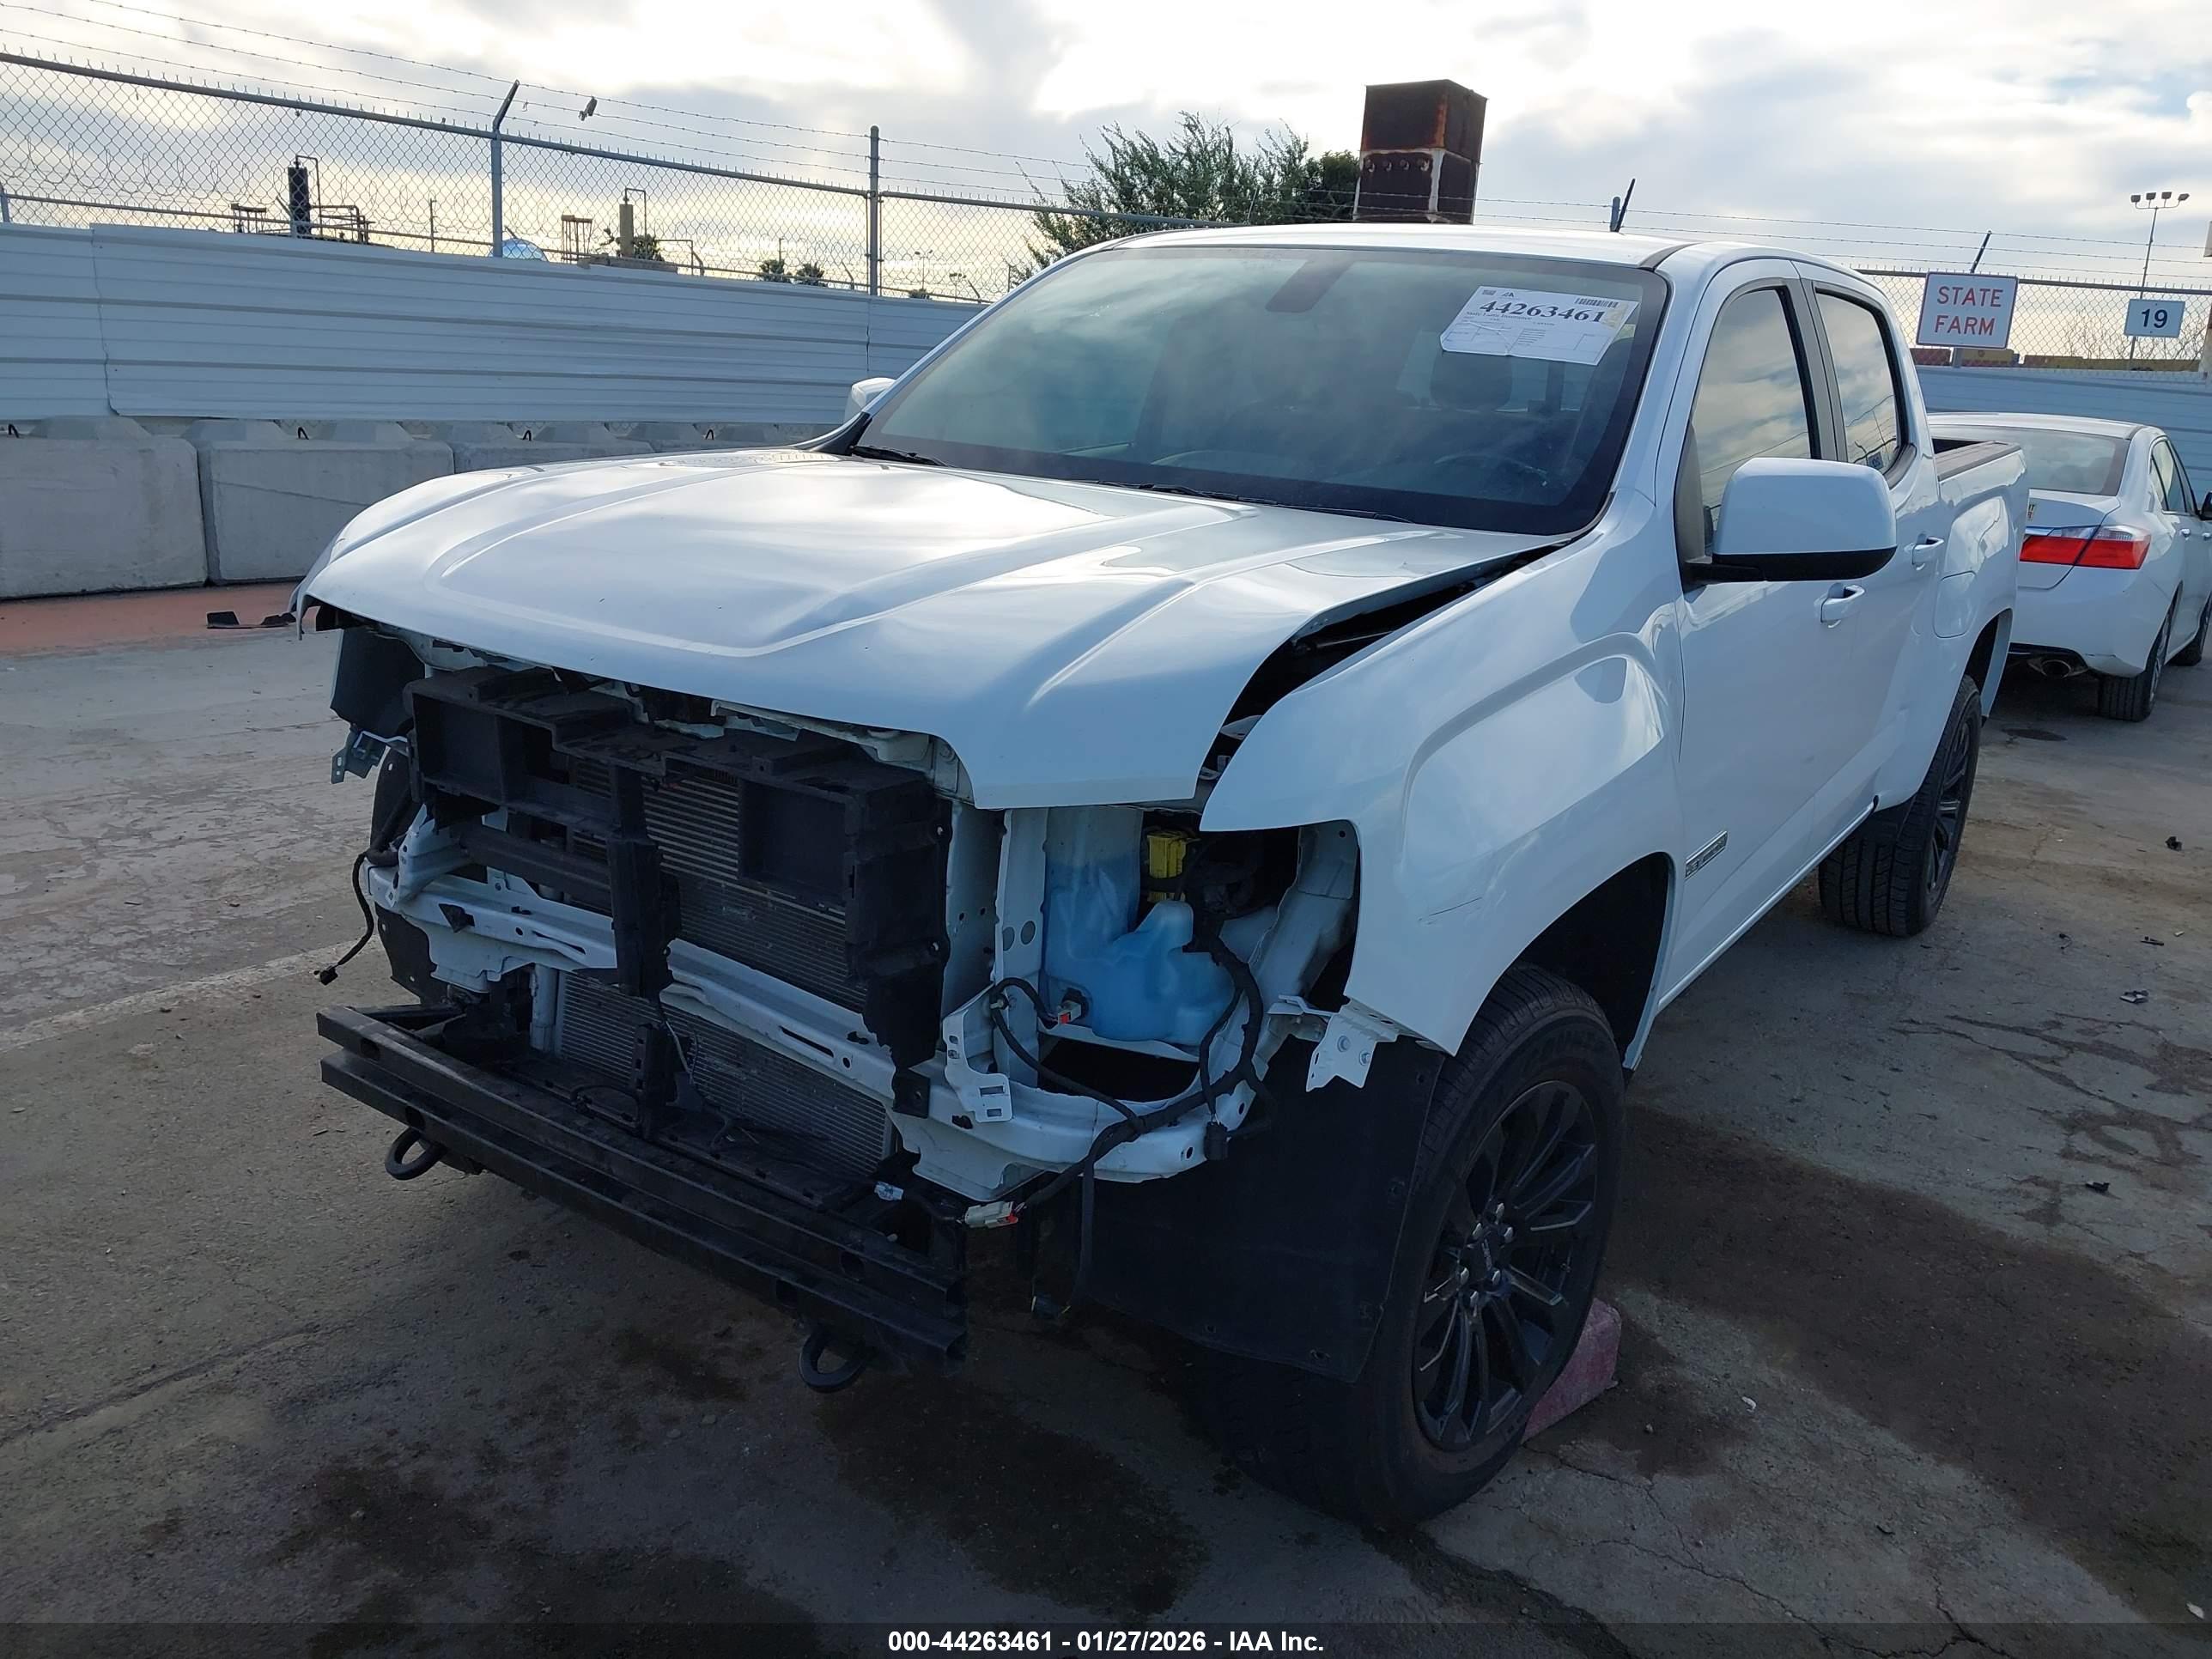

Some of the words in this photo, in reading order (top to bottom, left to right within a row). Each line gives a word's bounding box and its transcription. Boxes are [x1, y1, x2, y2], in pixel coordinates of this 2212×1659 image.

[1936, 286, 2004, 307] STATE
[1480, 301, 1606, 323] 44263461
[2141, 308, 2168, 328] 19
[1934, 314, 1996, 336] FARM
